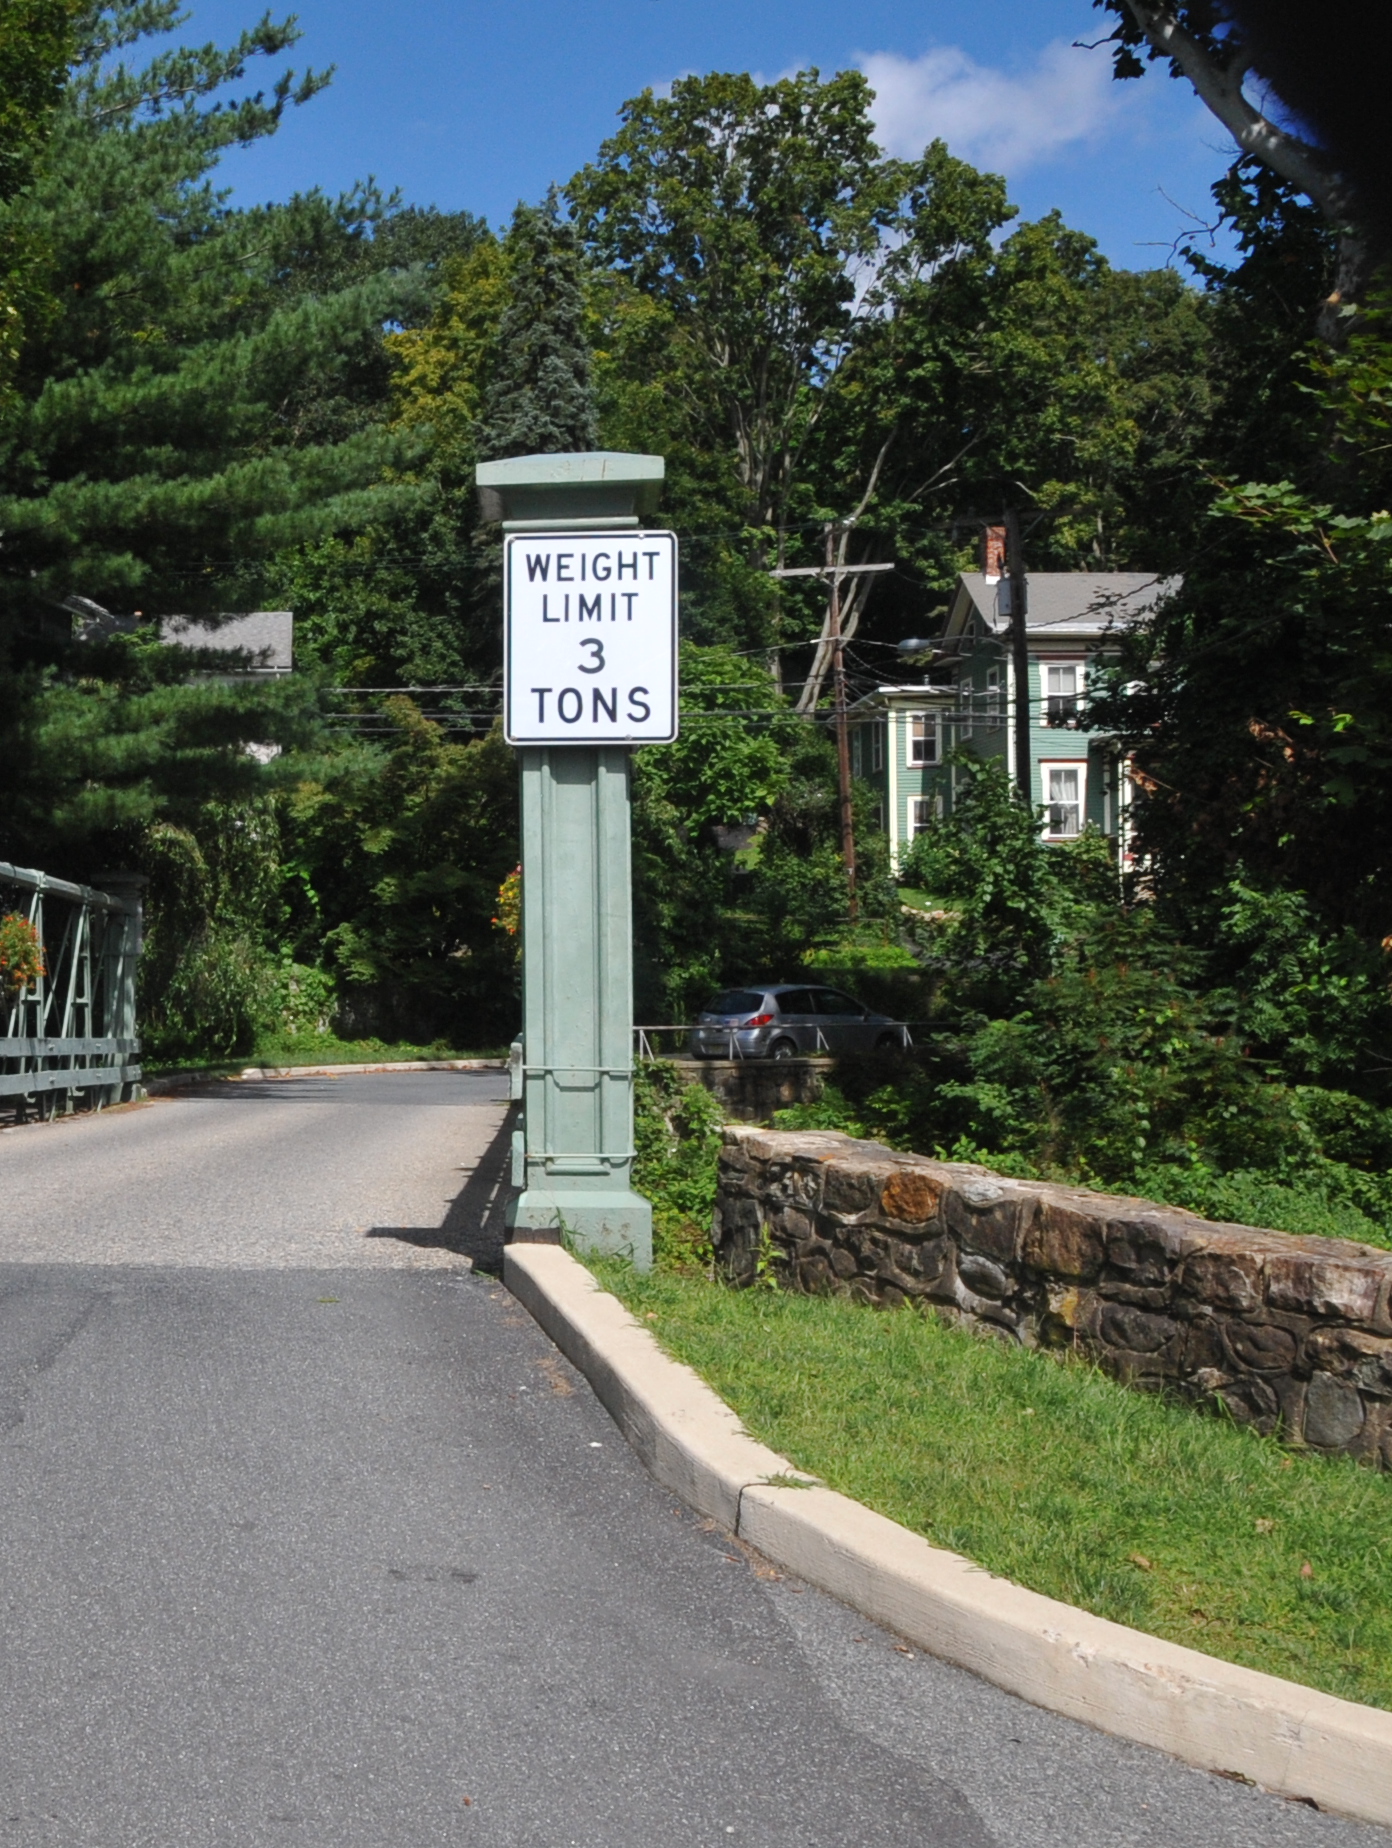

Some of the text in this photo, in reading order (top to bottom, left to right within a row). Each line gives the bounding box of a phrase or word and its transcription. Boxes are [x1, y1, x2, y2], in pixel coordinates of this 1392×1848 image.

[526, 551, 661, 582] WEIGHT
[542, 593, 639, 622] LIMIT
[577, 638, 606, 674] 3
[530, 686, 651, 724] TONS
